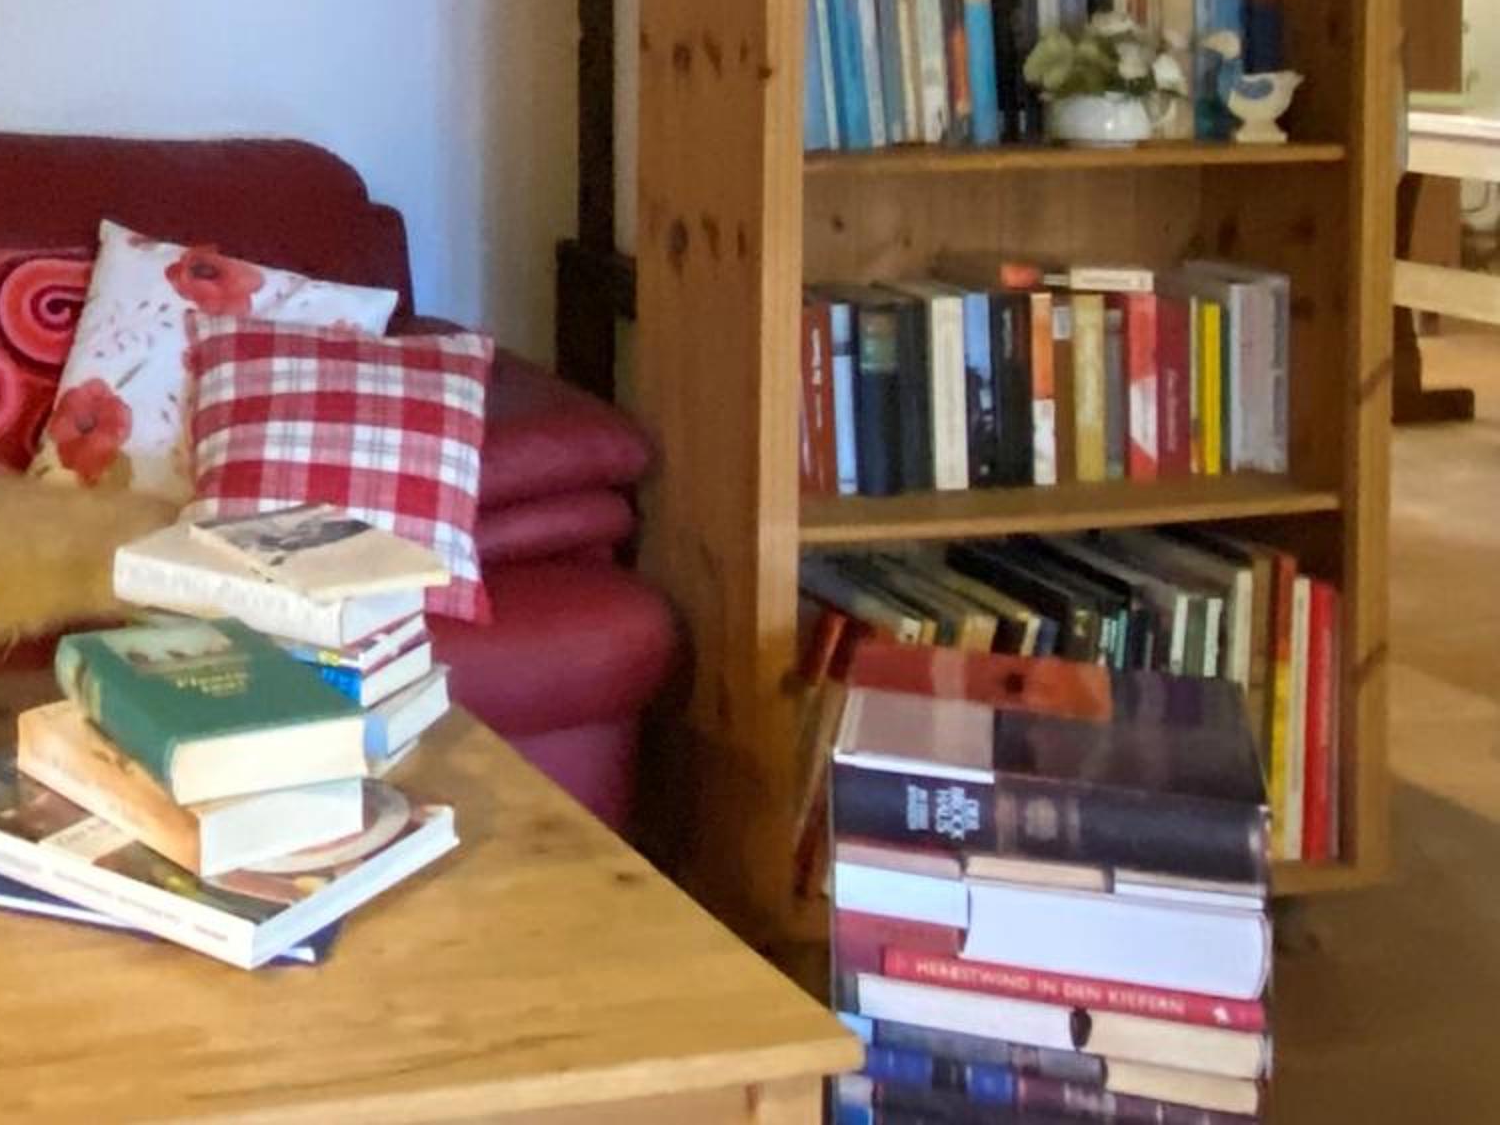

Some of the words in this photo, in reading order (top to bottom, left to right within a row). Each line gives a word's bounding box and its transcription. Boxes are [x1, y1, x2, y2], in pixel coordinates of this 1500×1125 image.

[916, 961, 1030, 989] HERBSTWIND
[1036, 980, 1059, 996] IN
[1063, 982, 1103, 1001] DEN
